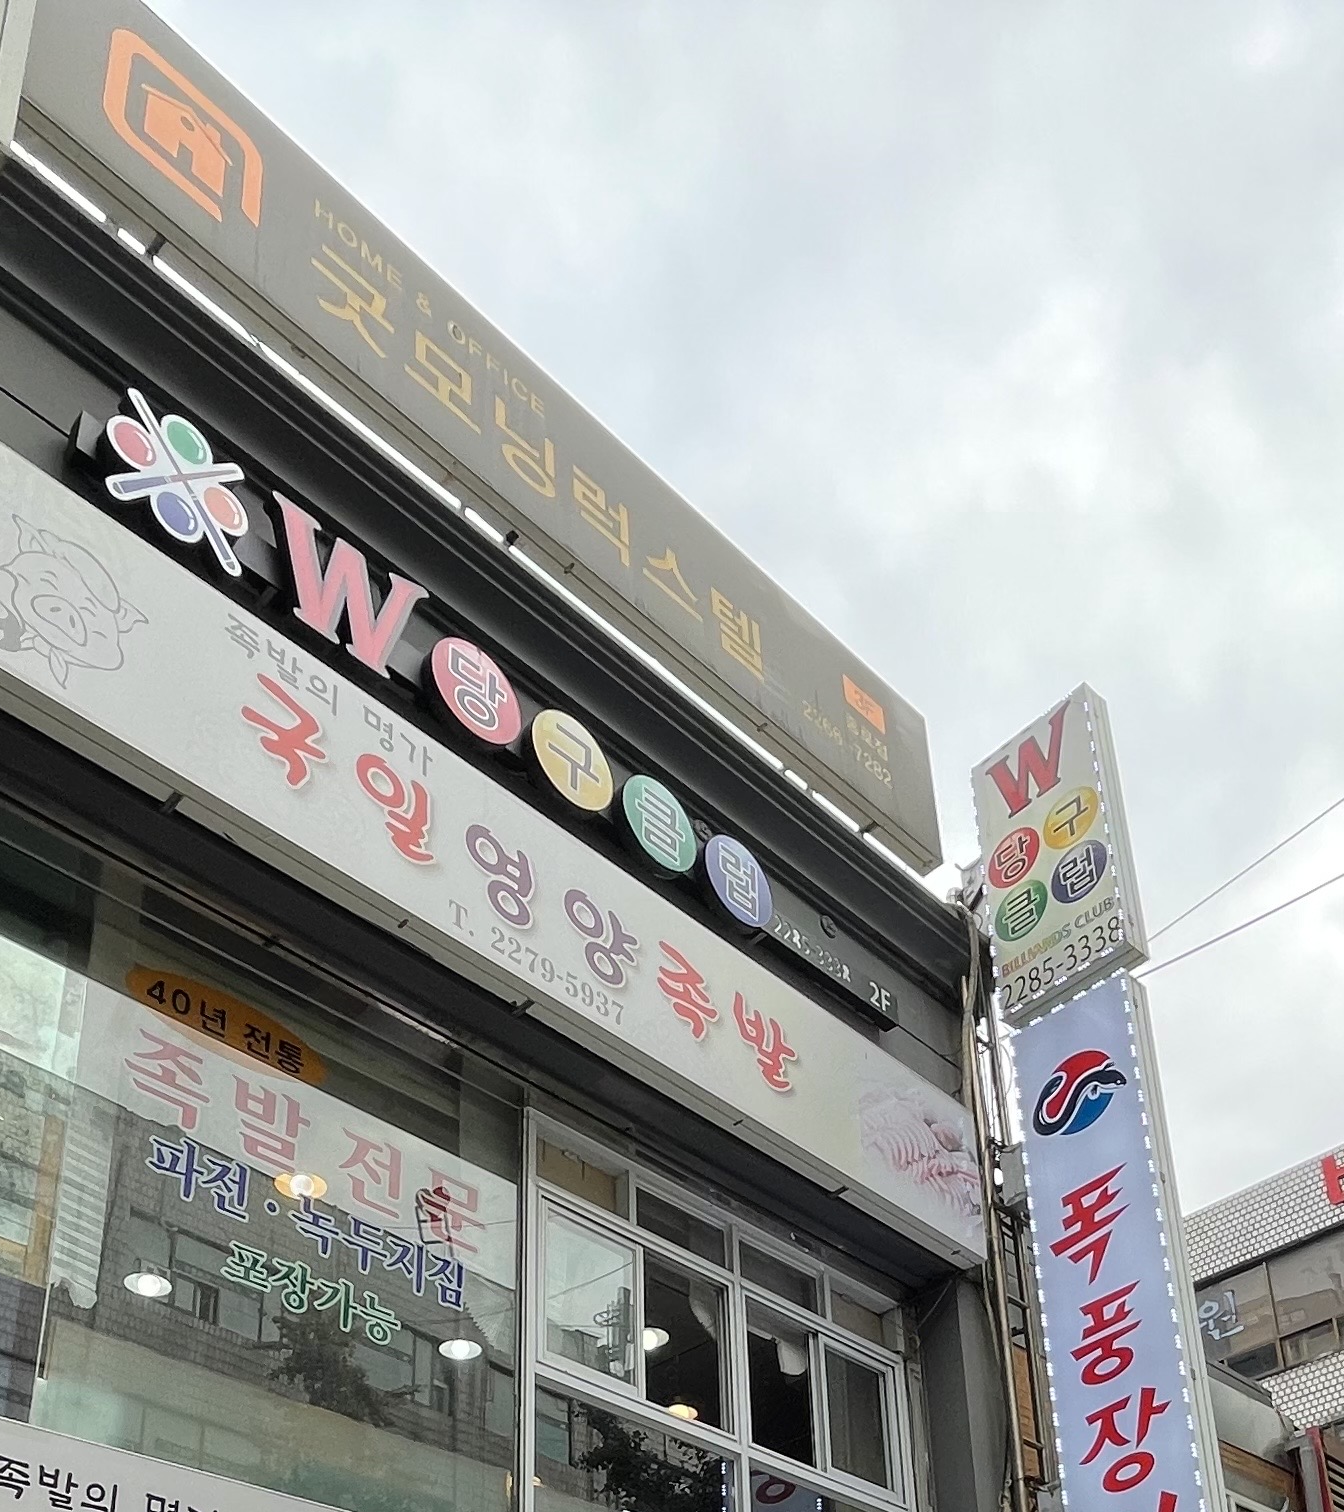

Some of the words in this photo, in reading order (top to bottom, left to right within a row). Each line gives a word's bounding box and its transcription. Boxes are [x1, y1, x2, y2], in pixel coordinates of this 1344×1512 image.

[312, 198, 405, 292] HOME
[416, 292, 433, 319] &
[448, 318, 547, 415] OFFICE
[311, 243, 766, 683] 굿모닝럭스텔
[225, 611, 341, 718] 족발의
[362, 702, 436, 767] 명가
[272, 489, 430, 680] W
[436, 640, 768, 928] 당구클럽
[985, 699, 1071, 819] W
[239, 670, 799, 1096] 국일영양족발
[1074, 895, 1115, 931] CLUB
[146, 978, 229, 1040] 40년
[242, 1020, 307, 1075] 전통
[490, 924, 627, 1026] 2279-5937
[869, 981, 892, 1012] 2F
[1001, 915, 1121, 1010] 2285-3338
[124, 1027, 488, 1258] 족발전문
[148, 1136, 251, 1223] 파전
[291, 1196, 468, 1311] 녹두지짐
[220, 1241, 403, 1347] 포장가능
